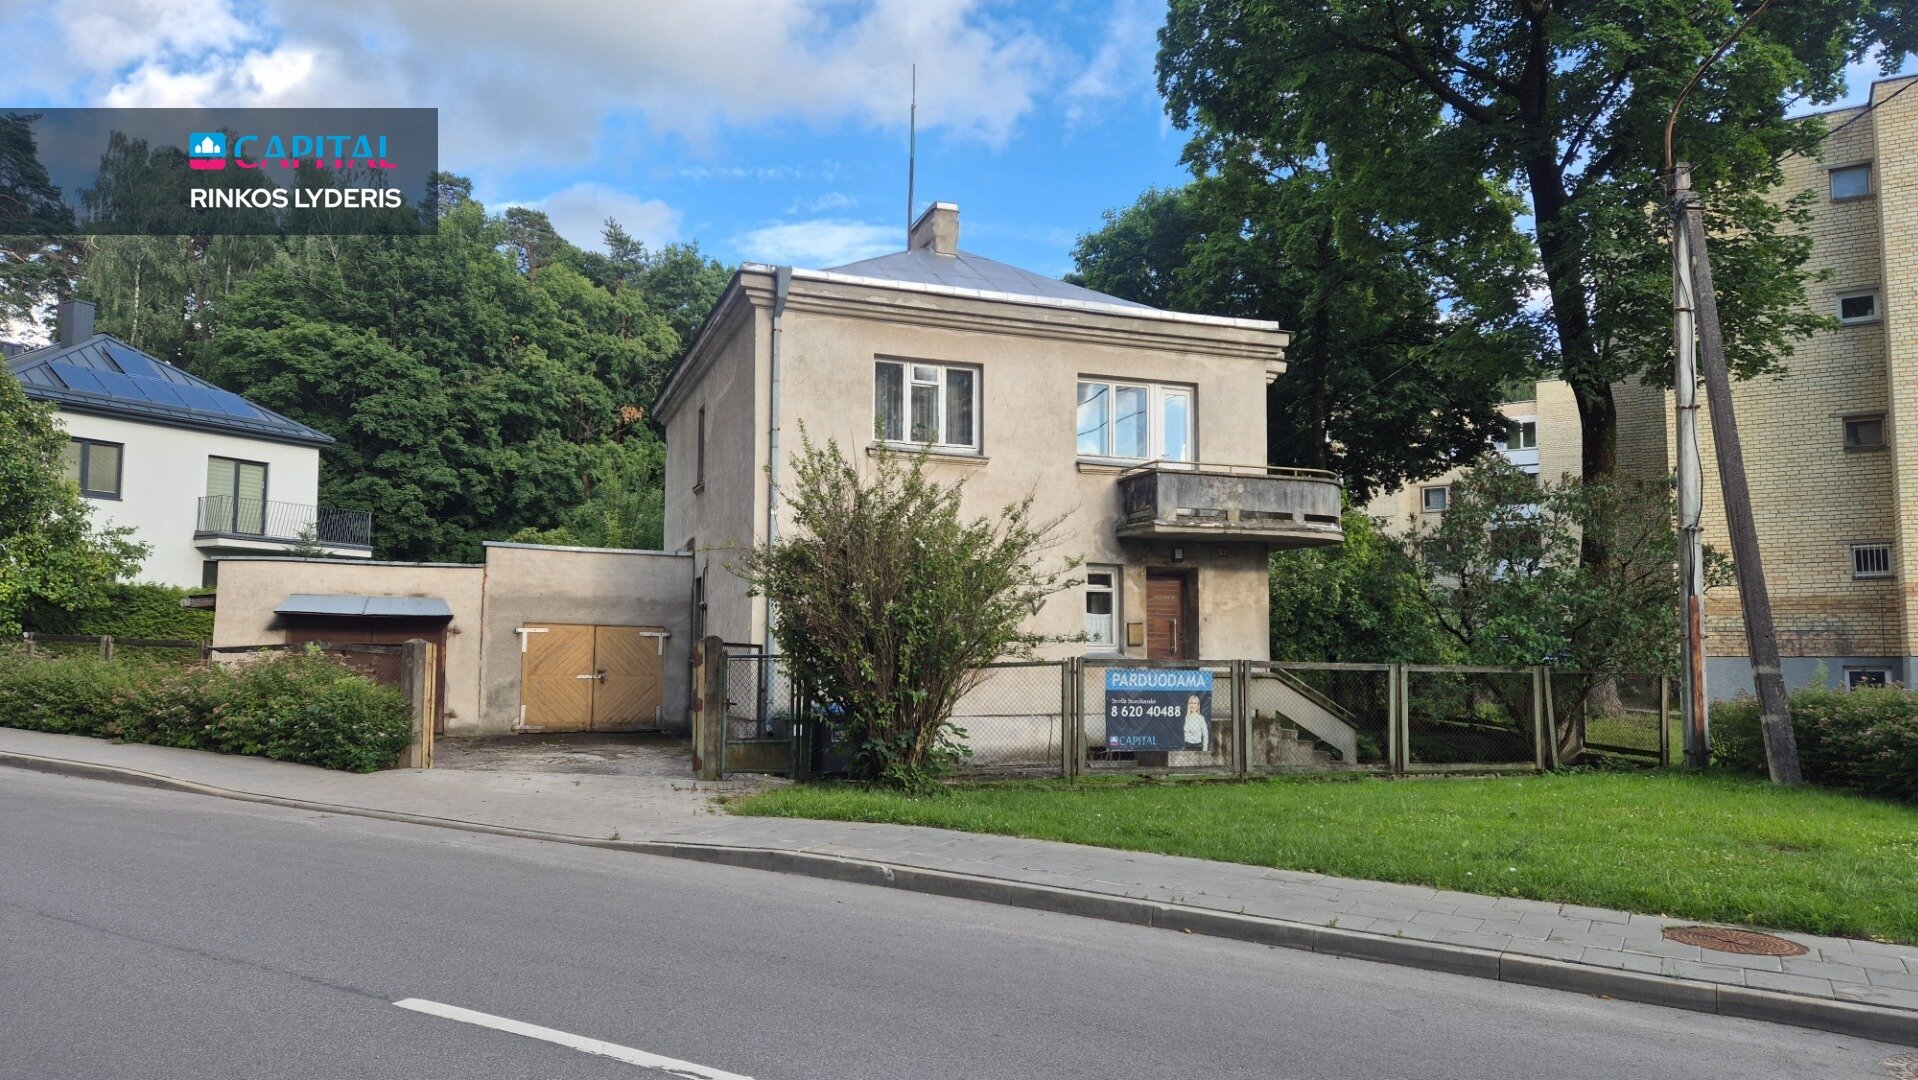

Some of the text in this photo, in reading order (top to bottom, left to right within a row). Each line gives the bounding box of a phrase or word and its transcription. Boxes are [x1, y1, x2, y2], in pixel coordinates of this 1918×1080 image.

[1112, 673, 1205, 687] PARDUODAMA
[1111, 706, 1181, 717] 8 620 40488
[1120, 736, 1157, 746] CAPITAL
